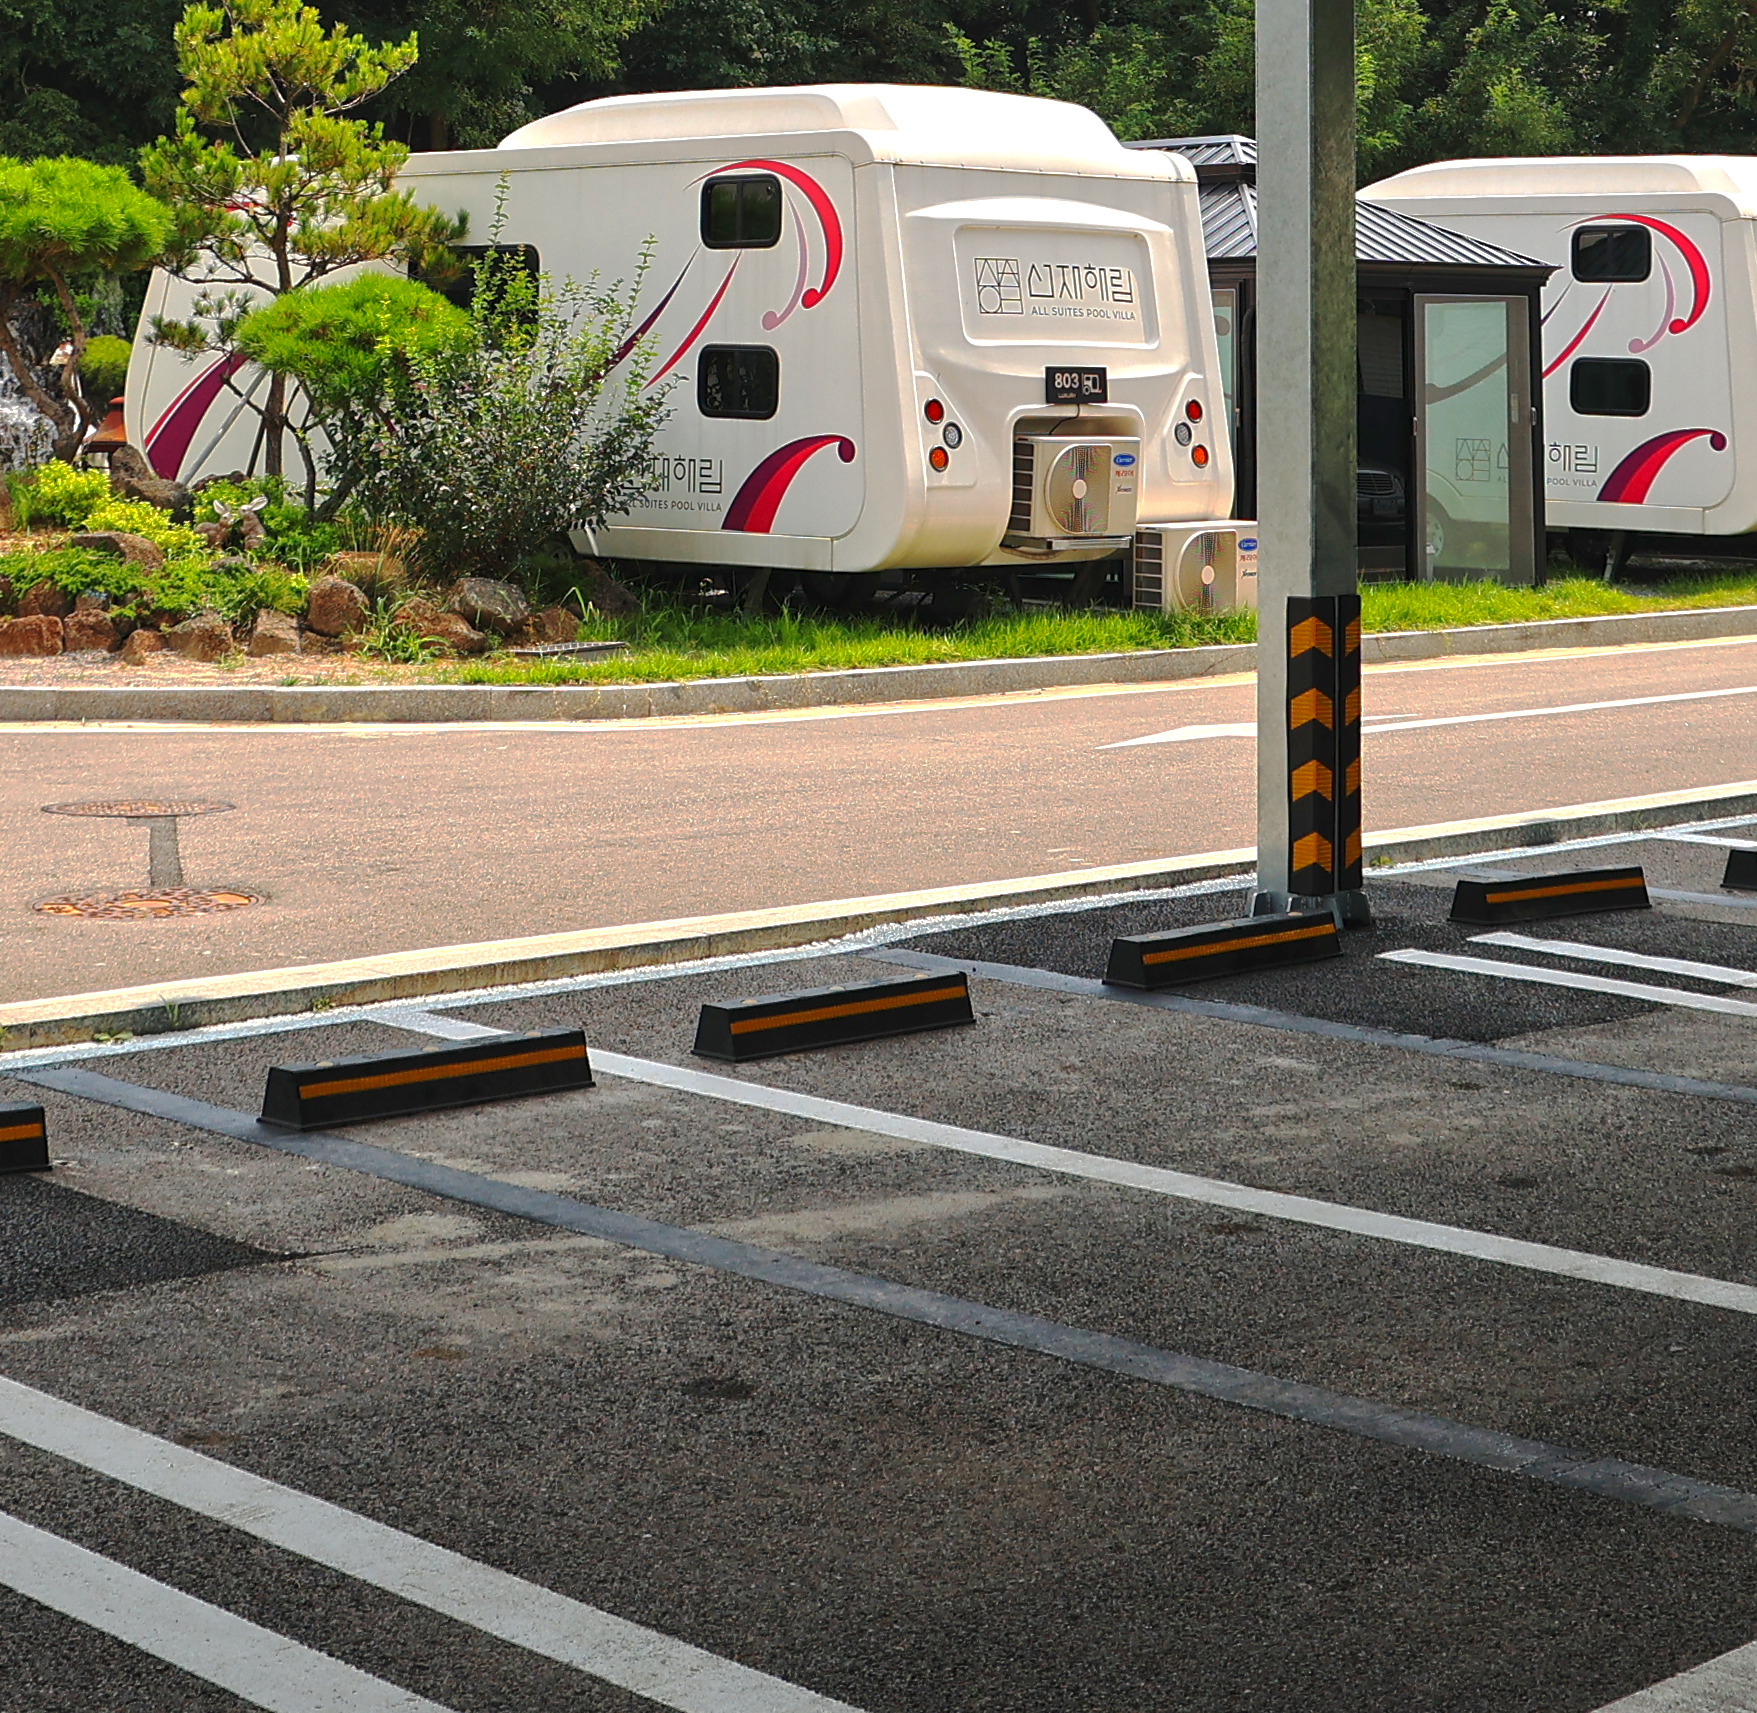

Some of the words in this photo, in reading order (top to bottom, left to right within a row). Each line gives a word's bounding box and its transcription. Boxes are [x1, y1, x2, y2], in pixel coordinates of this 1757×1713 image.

[1031, 306, 1049, 316] ALL
[1052, 306, 1084, 318] SUITES
[1086, 308, 1110, 320] POOL
[1112, 310, 1136, 321] VILLA
[1054, 372, 1080, 389] 803
[1546, 477, 1570, 486] POOL
[1573, 478, 1598, 487] VILLA
[671, 500, 695, 511] POOL
[697, 501, 723, 512] VILLA
